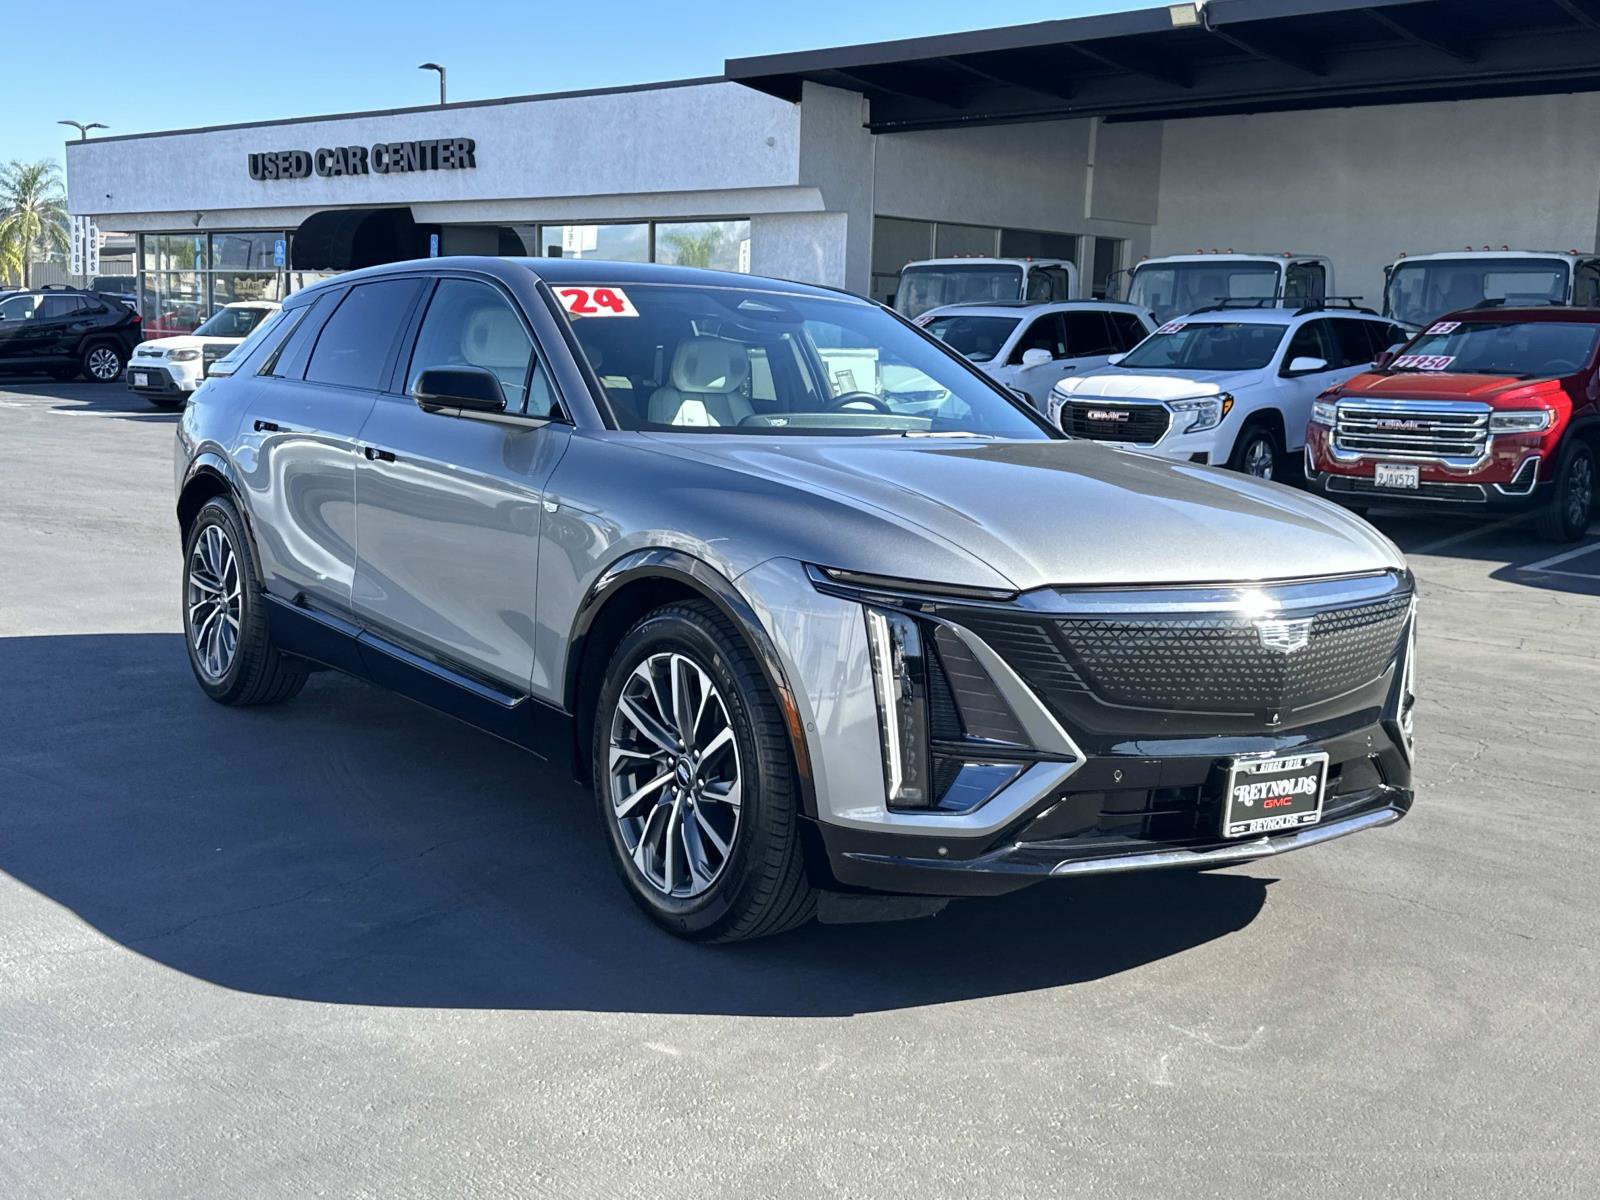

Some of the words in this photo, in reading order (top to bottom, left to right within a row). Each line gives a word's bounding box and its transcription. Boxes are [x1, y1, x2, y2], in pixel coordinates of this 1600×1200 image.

[248, 151, 312, 180] USED
[314, 146, 369, 176] CAR
[371, 138, 476, 173] CENTER
[560, 289, 625, 314] 24
[1376, 419, 1431, 431] GMC
[1234, 776, 1317, 807] REYNOLDS
[1263, 797, 1292, 809] GMC
[1250, 815, 1298, 833] REYNOLDS
